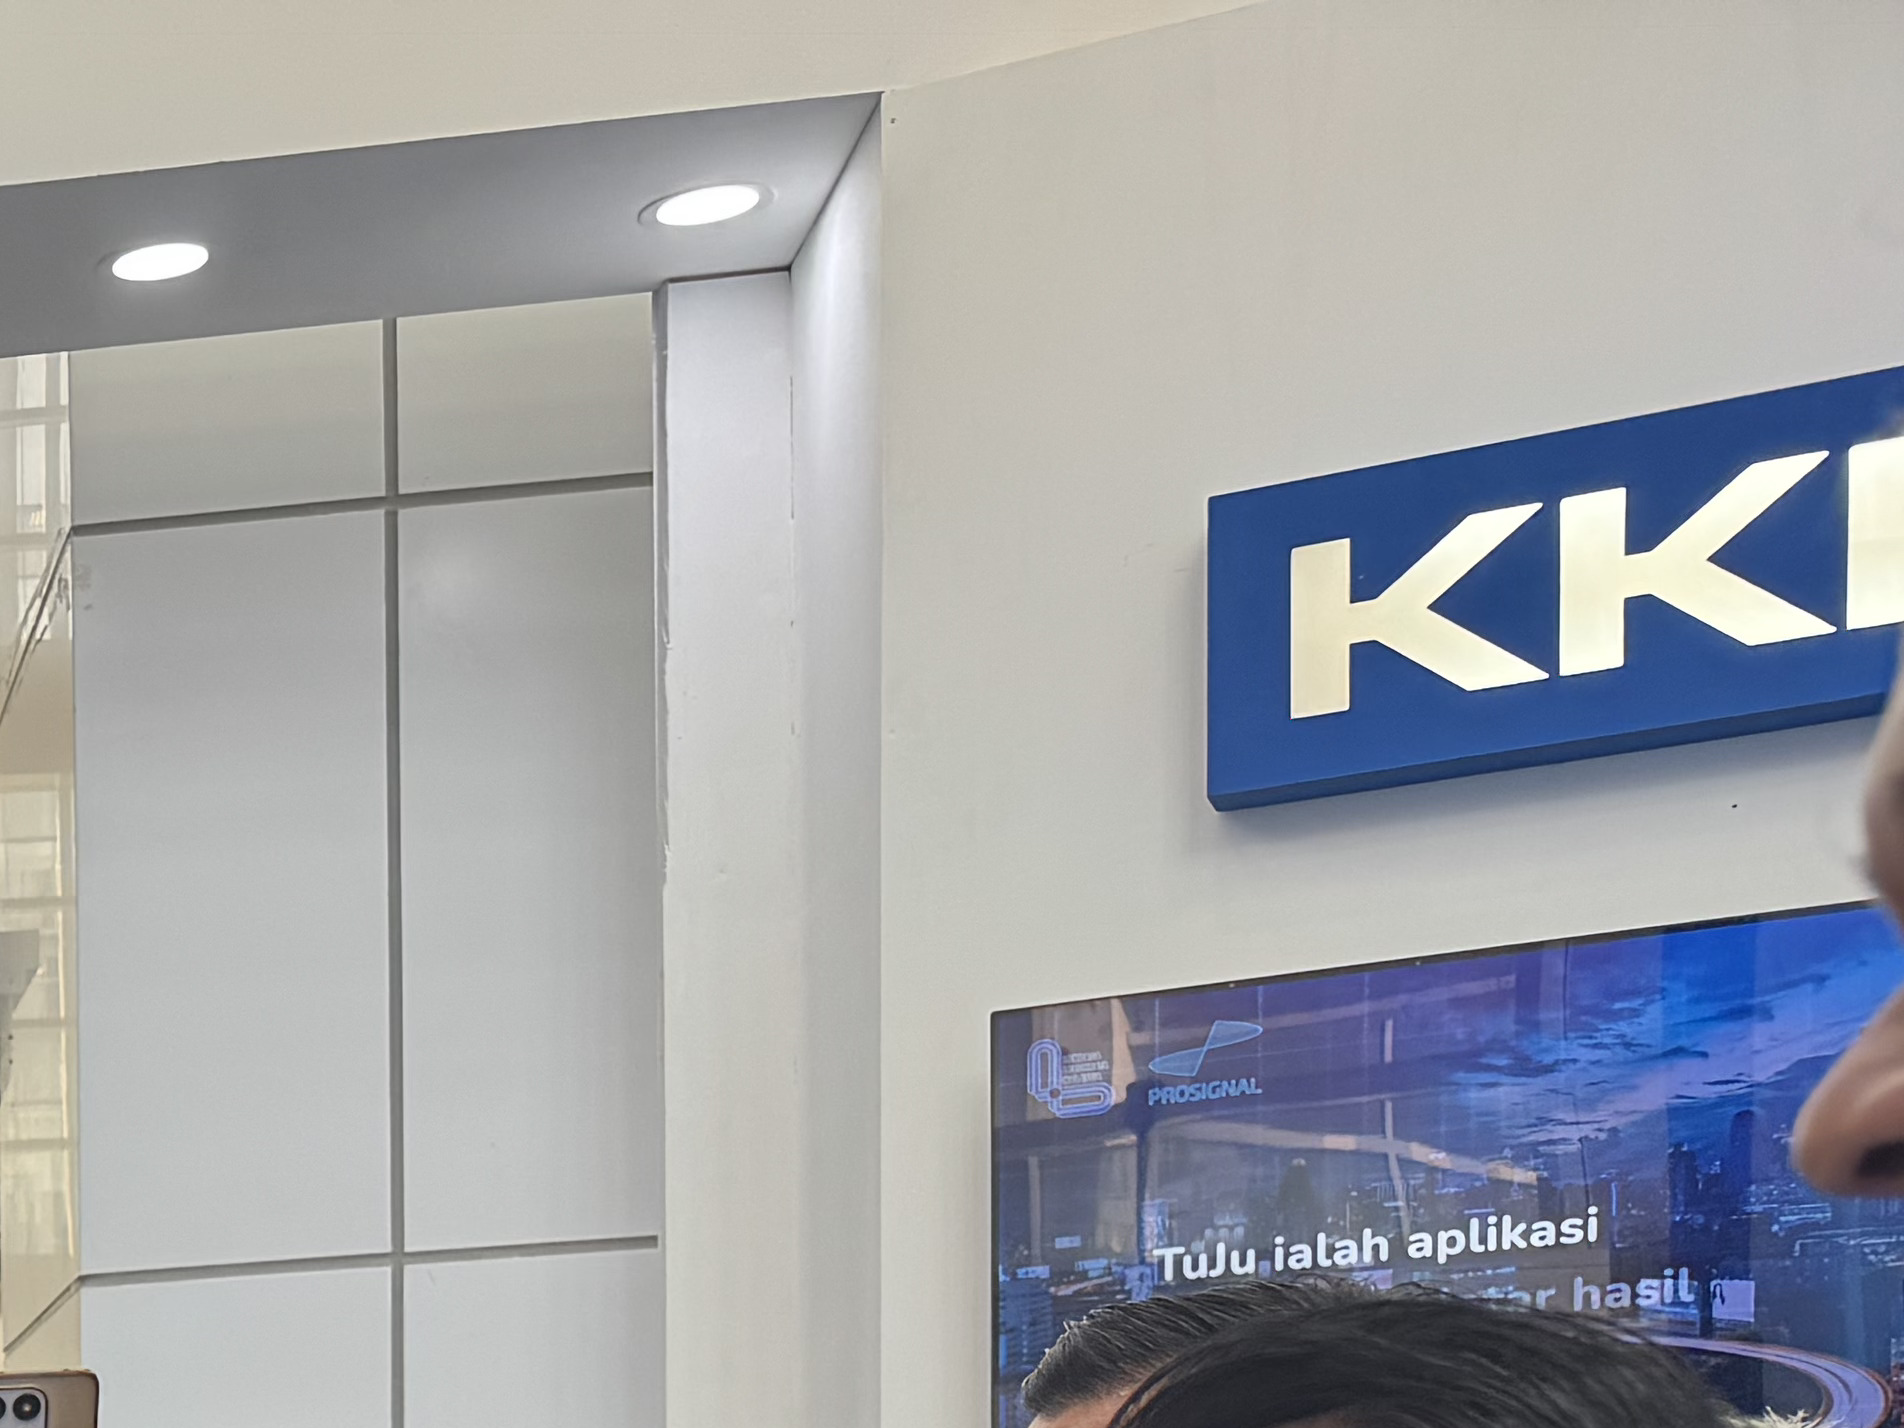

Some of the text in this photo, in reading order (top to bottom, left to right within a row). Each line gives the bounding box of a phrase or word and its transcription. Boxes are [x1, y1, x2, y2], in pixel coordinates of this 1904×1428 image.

[1147, 1077, 1263, 1106] PROSIGNAL
[1153, 1206, 1600, 1282] TuJu ialah aplikasi
[1573, 1266, 1696, 1312] hasil
